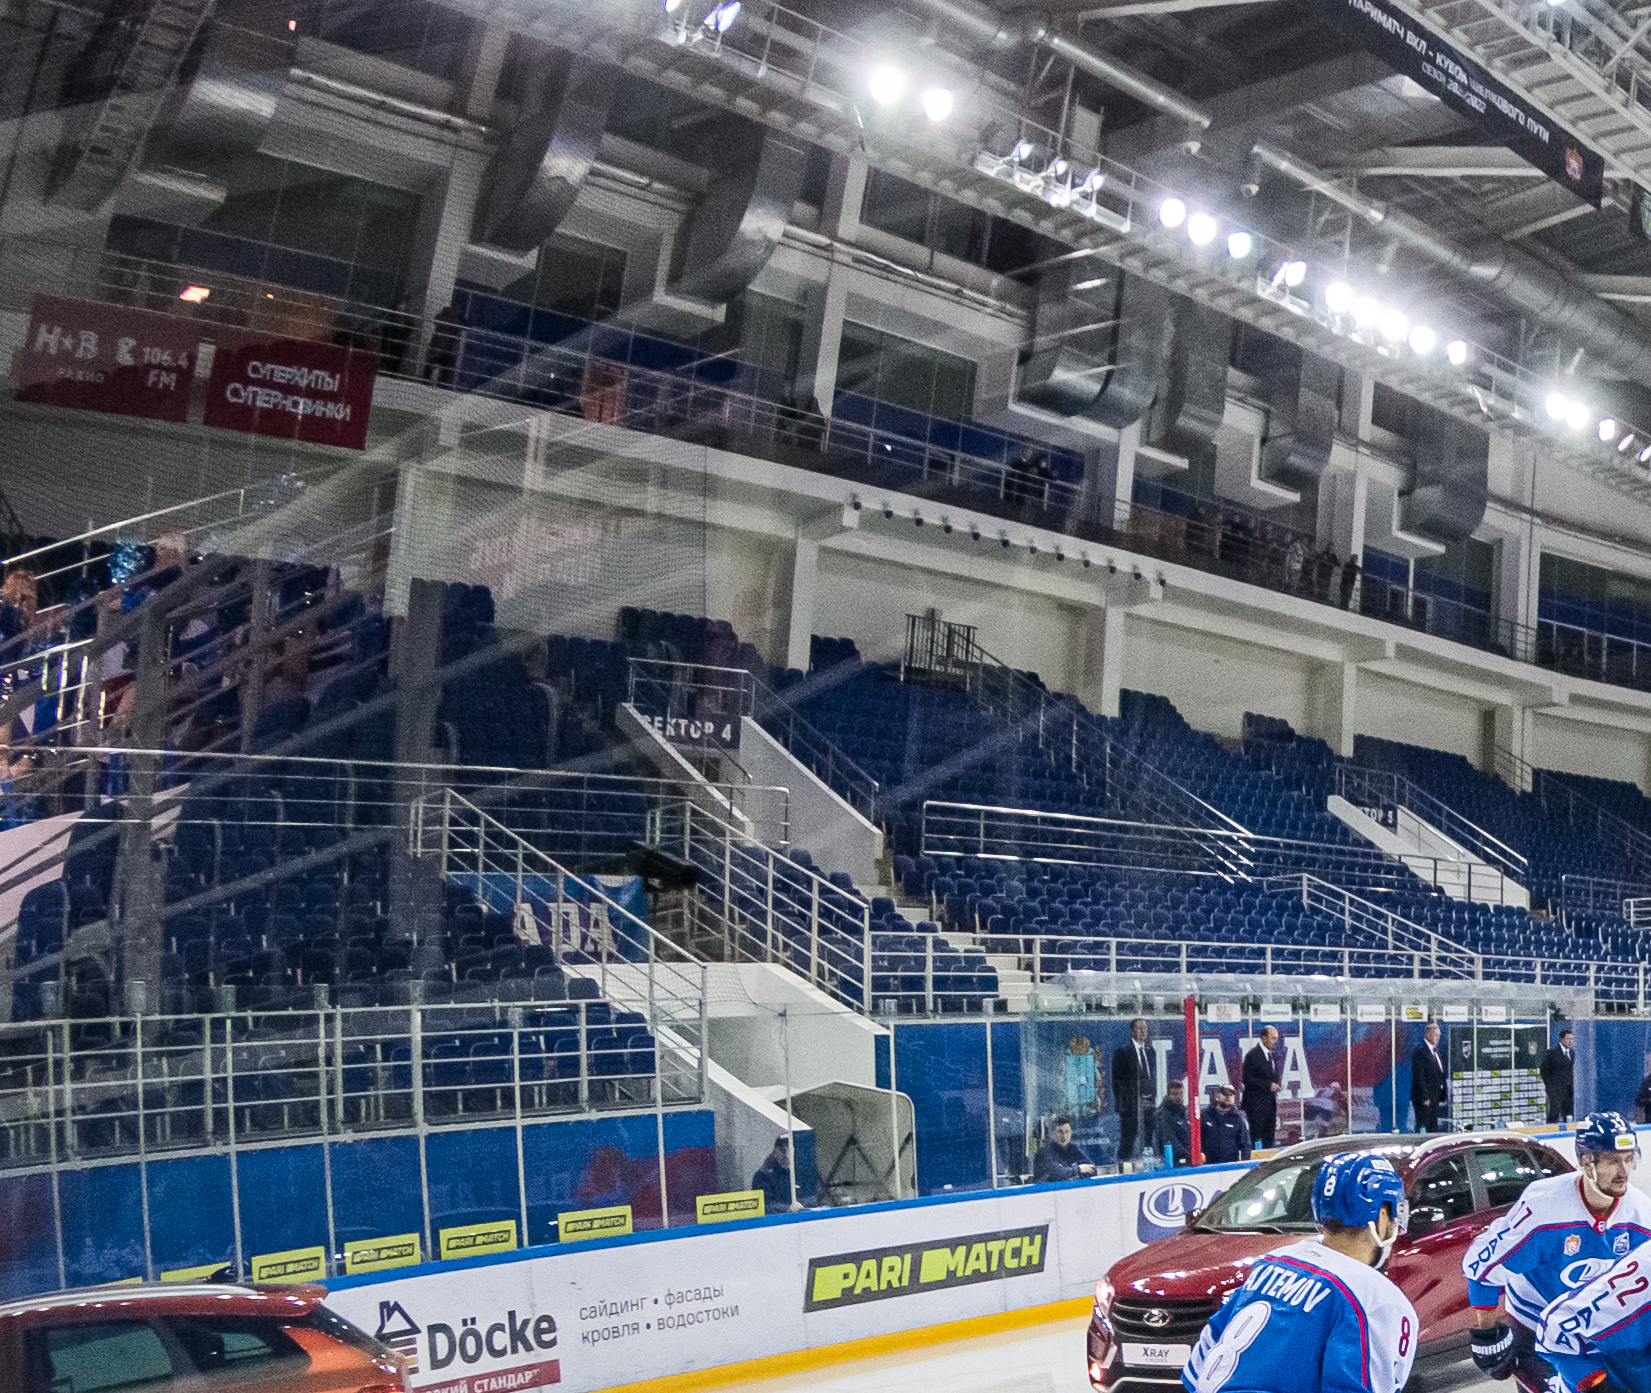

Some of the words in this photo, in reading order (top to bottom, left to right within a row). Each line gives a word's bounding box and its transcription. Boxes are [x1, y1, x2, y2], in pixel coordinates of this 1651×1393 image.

[148, 369, 178, 391] FM
[246, 360, 341, 392] СУПЕРХИТЫ
[226, 383, 351, 422] СУПЕРНОВИНКИ
[721, 723, 731, 742] 4
[1324, 1176, 1336, 1196] 8
[813, 1252, 912, 1302] PARI
[919, 1233, 1042, 1284] MATCH
[1468, 1226, 1511, 1276] LADA
[579, 1296, 647, 1321] сайдинг
[664, 1284, 725, 1310] фасады
[1608, 1261, 1649, 1307] 22
[426, 1309, 559, 1371] Döcke
[581, 1320, 641, 1346] кровля
[656, 1304, 740, 1332] водостоки
[1399, 1316, 1411, 1358] 8
[1555, 1290, 1610, 1350] LADA
[1142, 1346, 1170, 1359] XRAY
